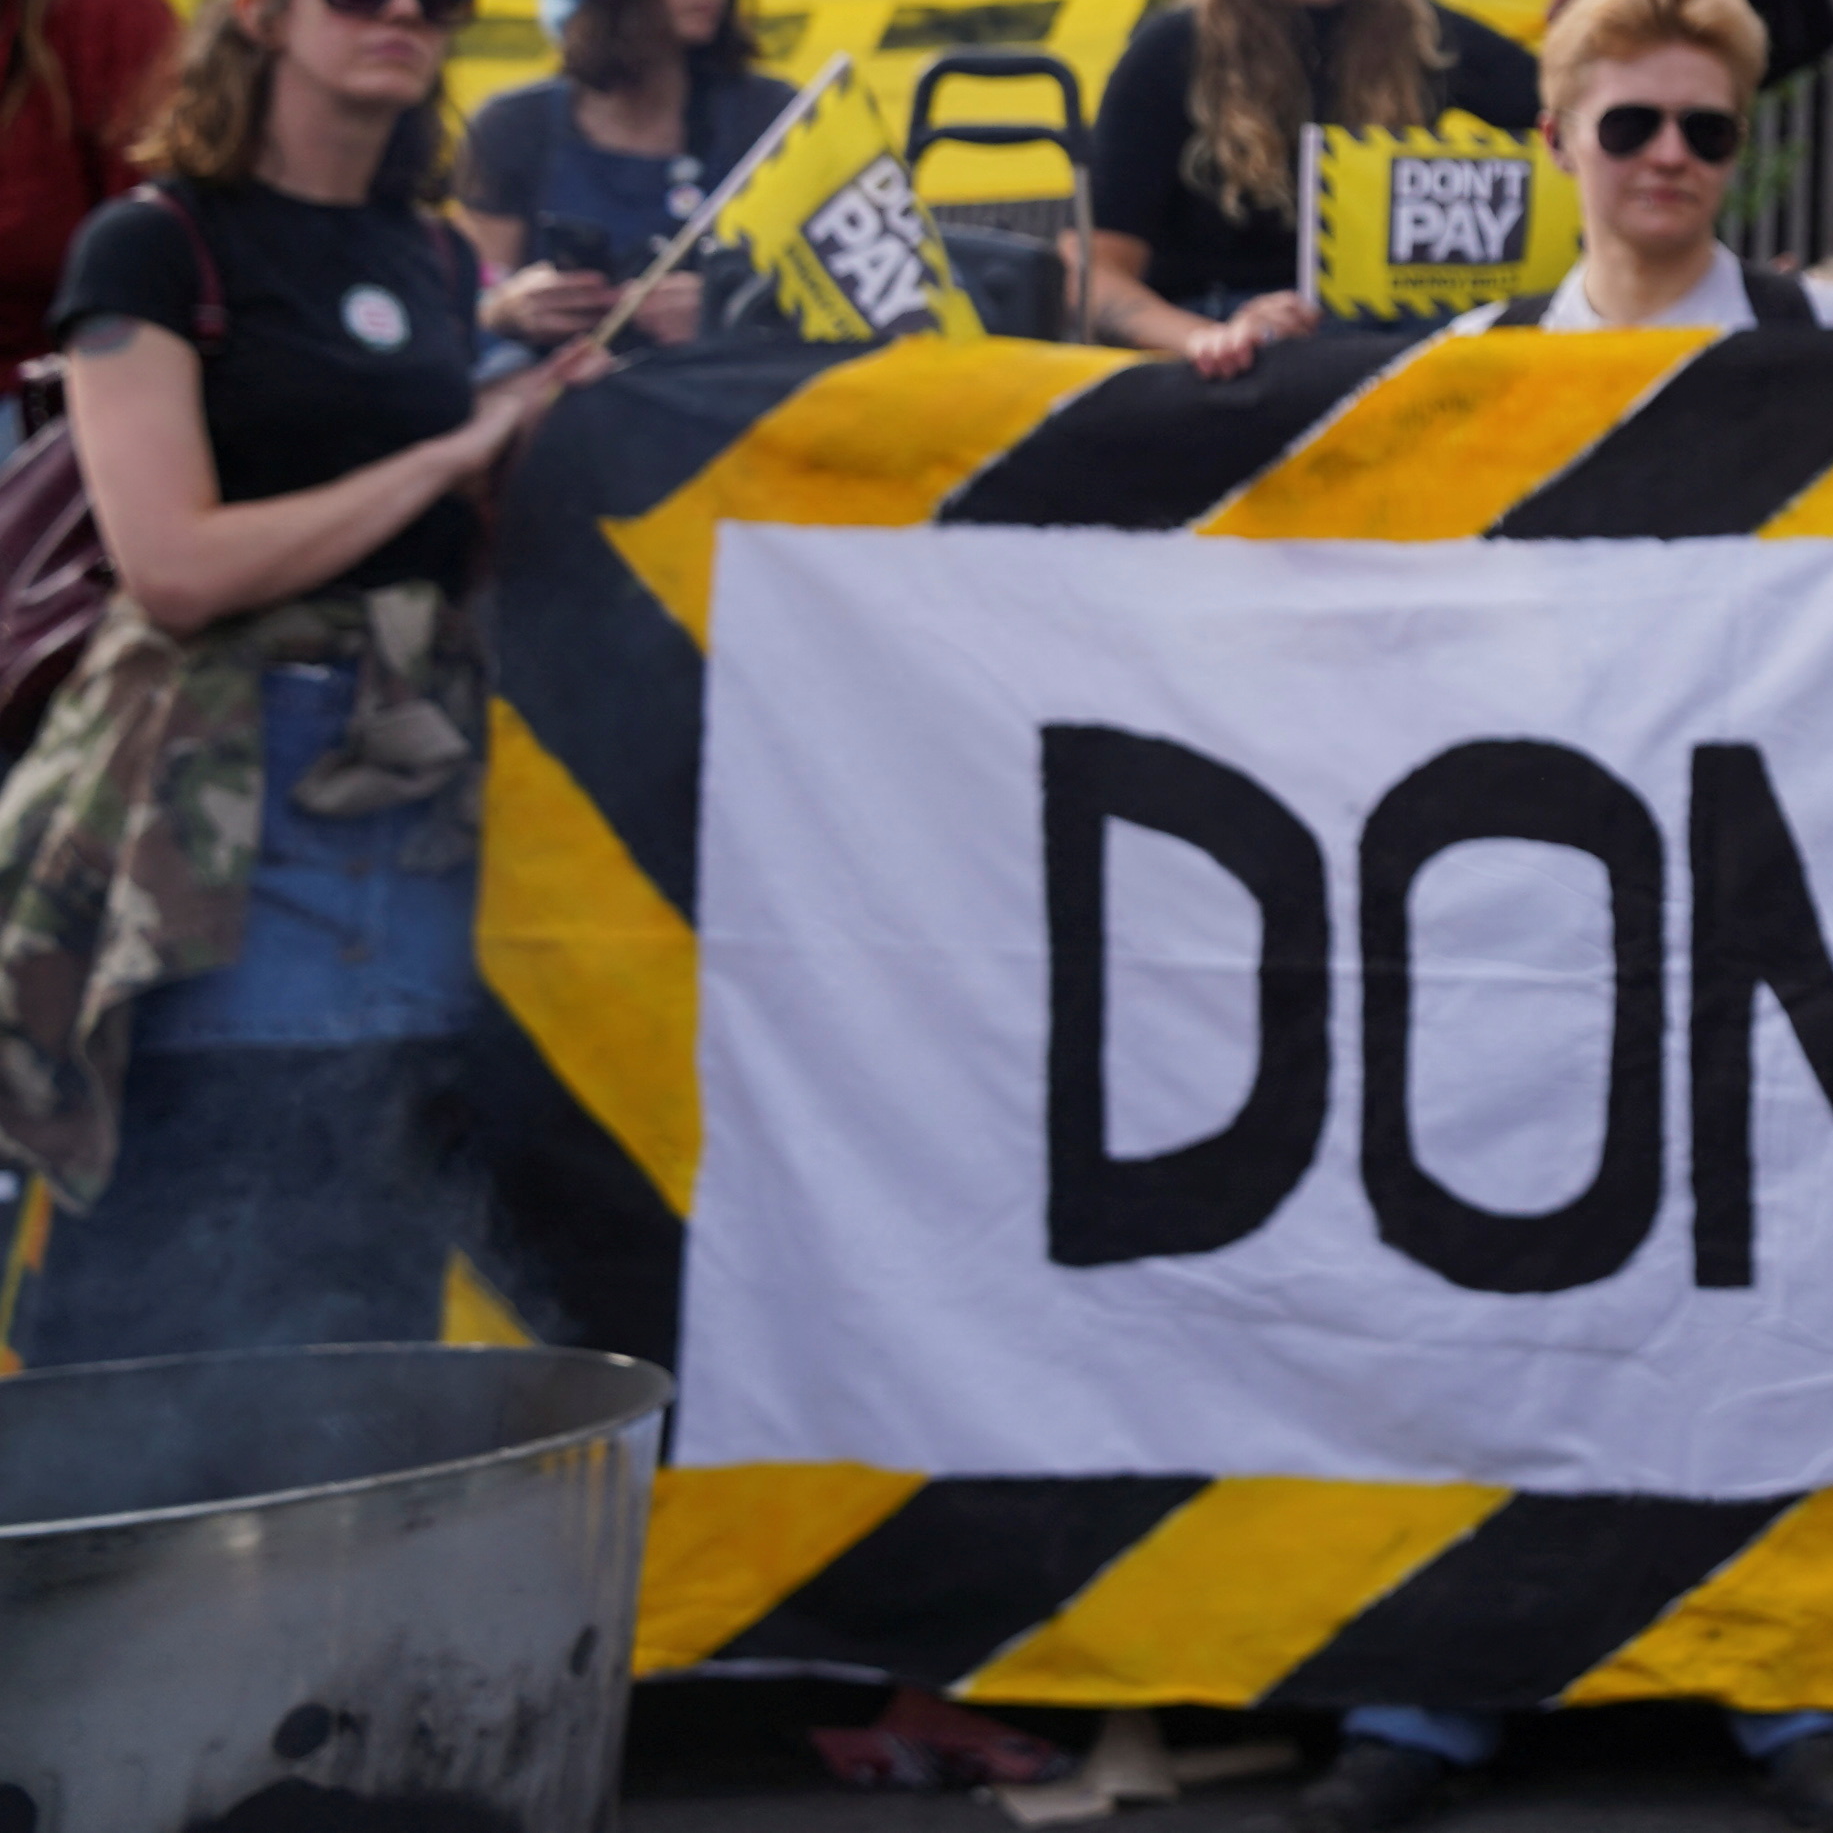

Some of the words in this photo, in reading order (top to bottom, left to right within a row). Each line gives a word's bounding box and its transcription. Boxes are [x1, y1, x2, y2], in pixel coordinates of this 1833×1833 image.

[1396, 156, 1532, 201] DON'T
[806, 189, 928, 329] PAY
[1391, 198, 1524, 263] PAY
